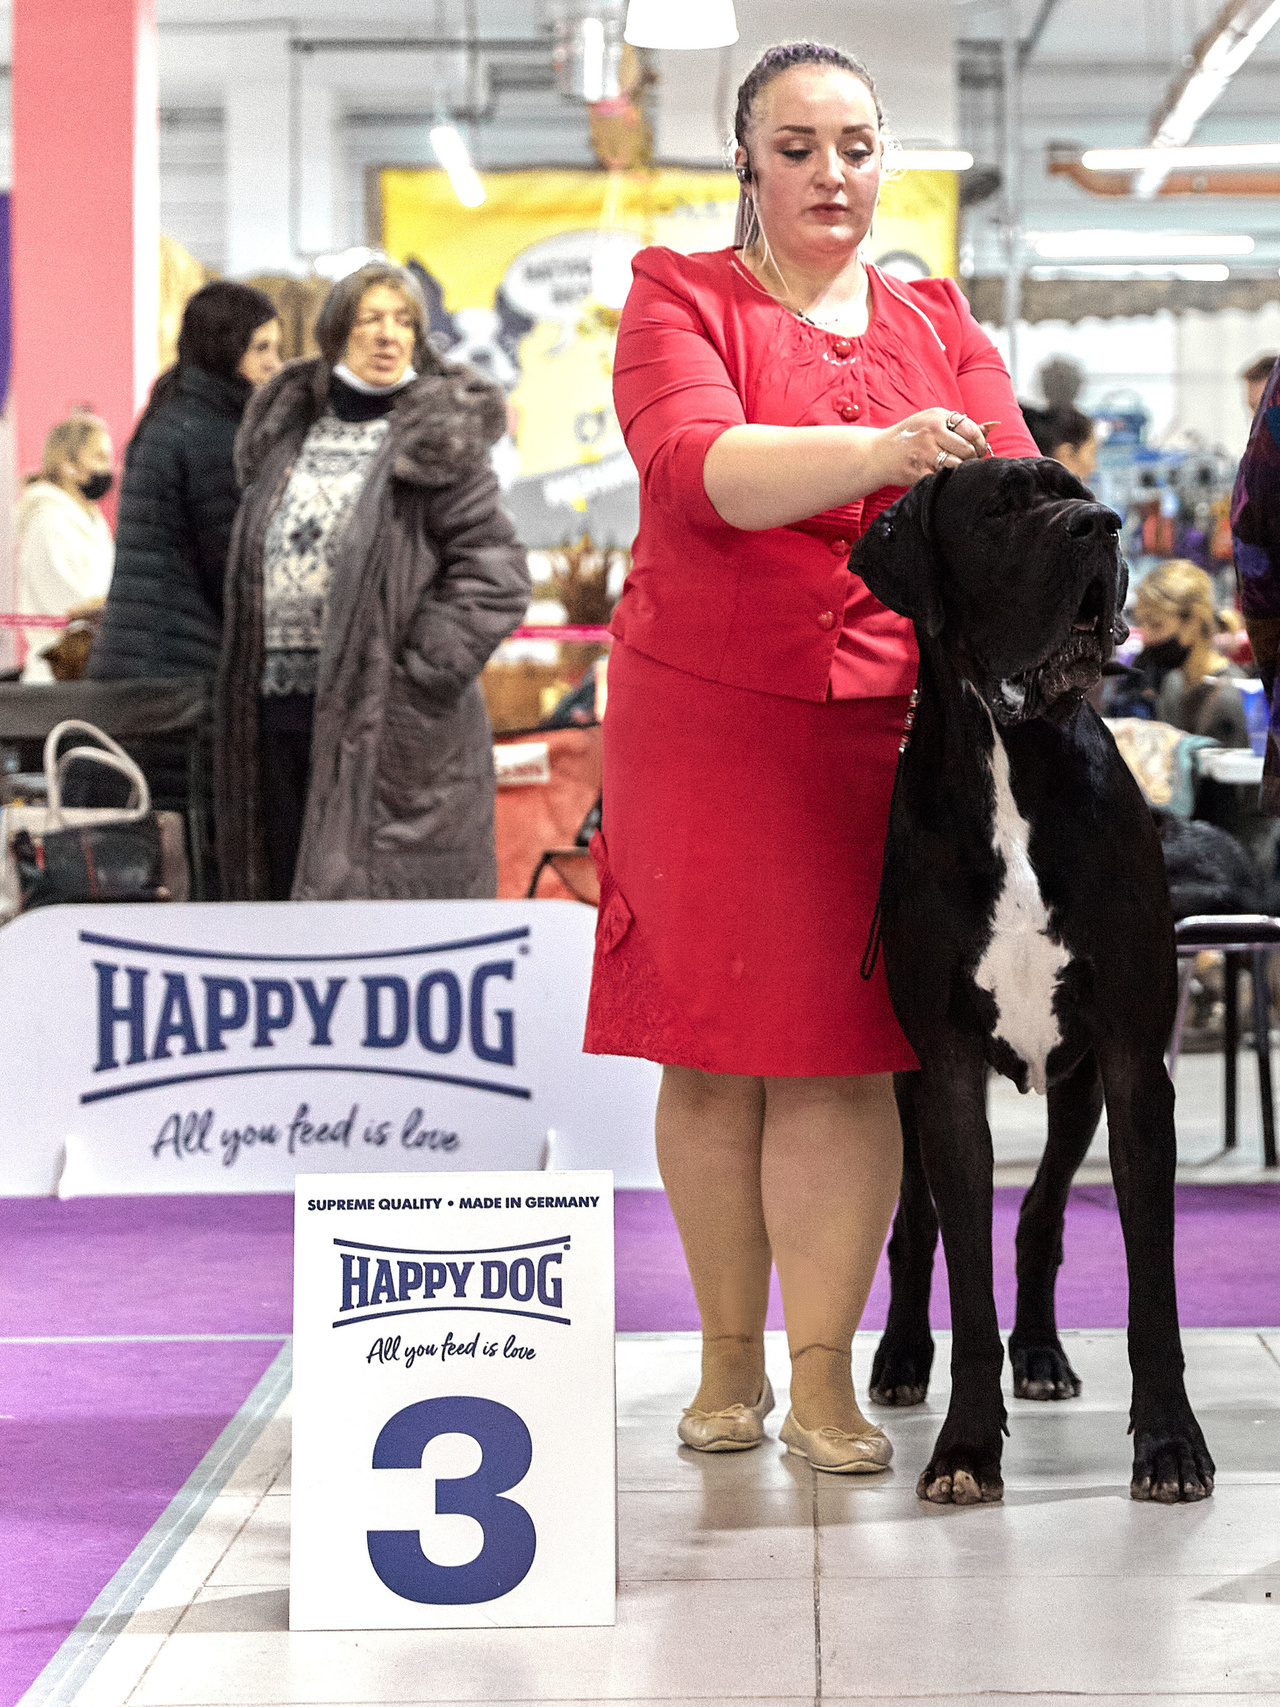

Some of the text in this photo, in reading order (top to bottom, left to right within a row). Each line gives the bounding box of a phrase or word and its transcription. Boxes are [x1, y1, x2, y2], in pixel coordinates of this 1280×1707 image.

[92, 959, 516, 1073] HAPPY DOG
[152, 1103, 460, 1166] All you feed is love
[307, 1196, 600, 1211] SUPREME QUALITY MADE IN GERMANY
[339, 1252, 563, 1313] HAPPY DOG
[366, 1332, 537, 1368] All you feed is love
[367, 1396, 536, 1605] 3
